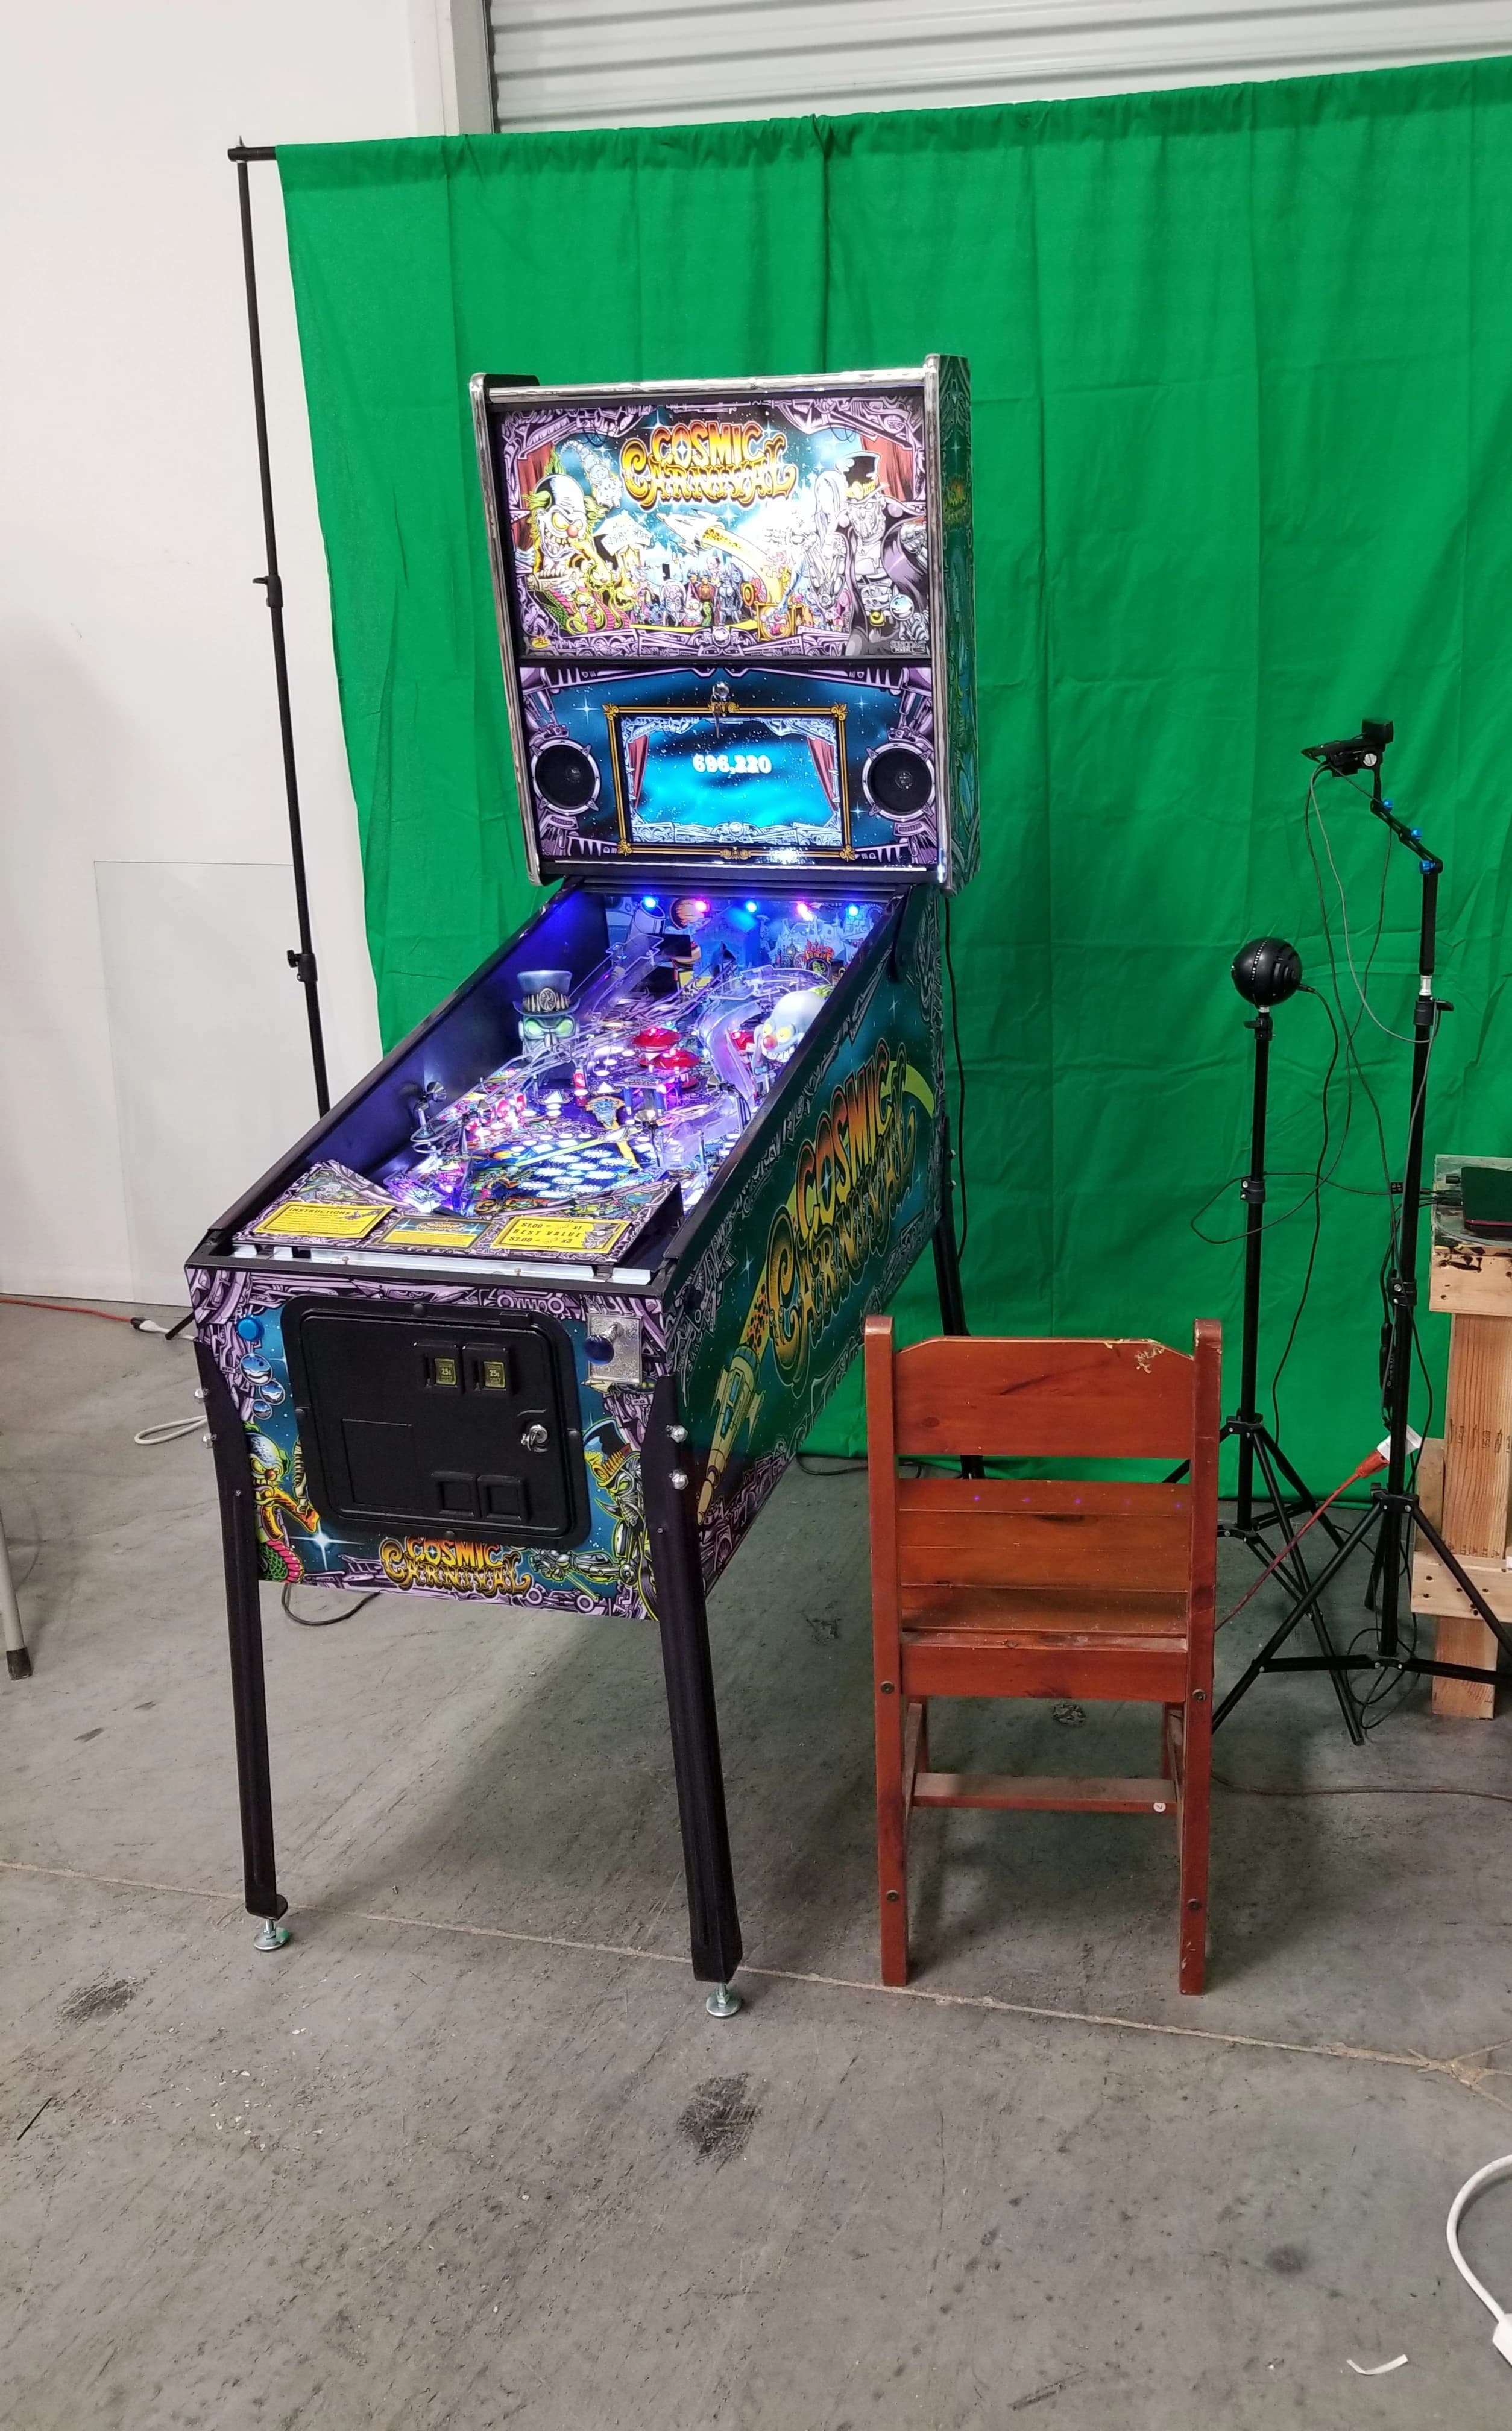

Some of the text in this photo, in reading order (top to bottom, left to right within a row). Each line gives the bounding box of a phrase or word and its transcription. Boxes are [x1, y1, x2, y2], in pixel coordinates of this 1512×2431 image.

[621, 434, 798, 509] CARNIVAL
[651, 420, 764, 467] COSMIC
[693, 754, 772, 774] 696,220
[796, 1038, 892, 1249] COSMIC
[767, 1042, 916, 1399] CARNIVAL
[379, 1538, 533, 1599] CARNIVAL
[405, 1537, 503, 1568] COSMIC
